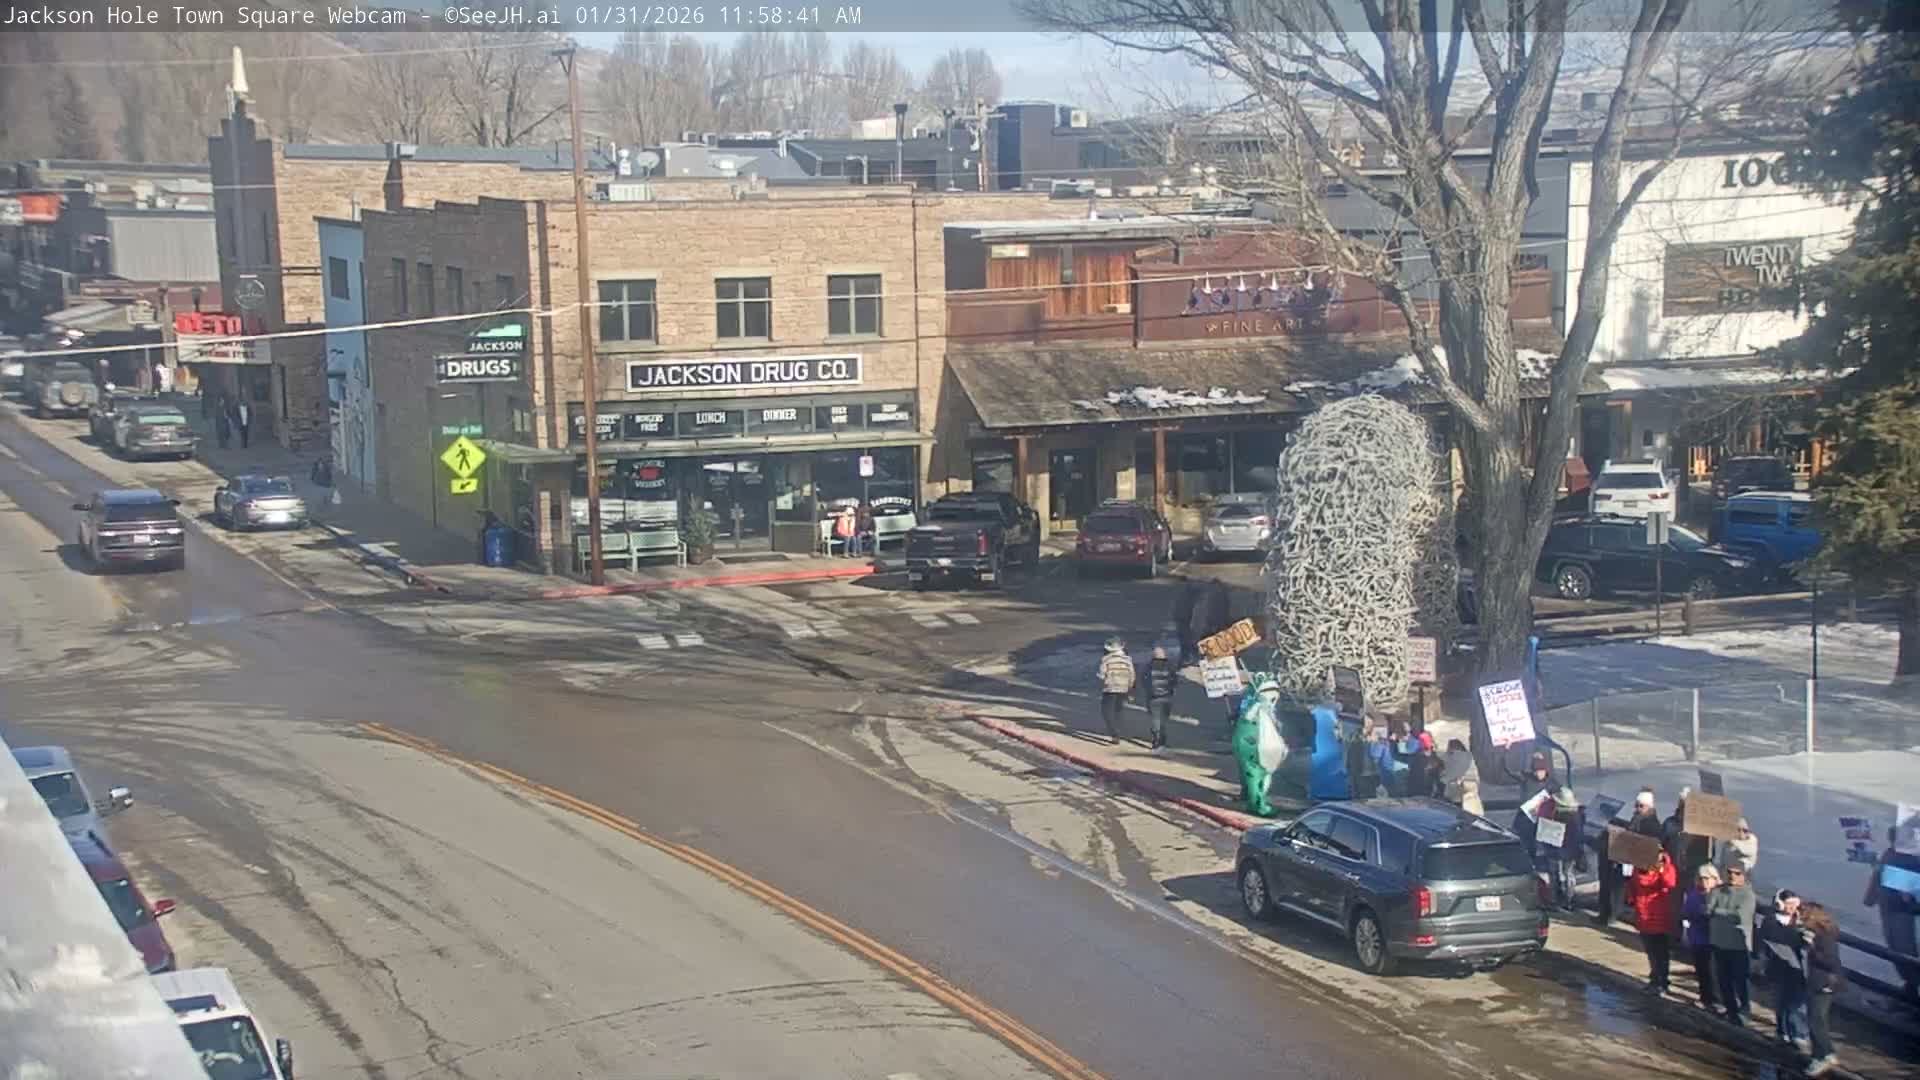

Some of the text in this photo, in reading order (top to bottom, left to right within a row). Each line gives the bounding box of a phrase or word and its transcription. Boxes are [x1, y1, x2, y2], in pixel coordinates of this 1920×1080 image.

[1725, 244, 1799, 266] TWENTY
[1222, 317, 1305, 333] FINE ART
[469, 341, 523, 351] JACKSON
[447, 359, 511, 376] DRUGS
[639, 363, 742, 386] JACKSON
[750, 360, 809, 383] DRUG
[762, 408, 798, 422] DINNER
